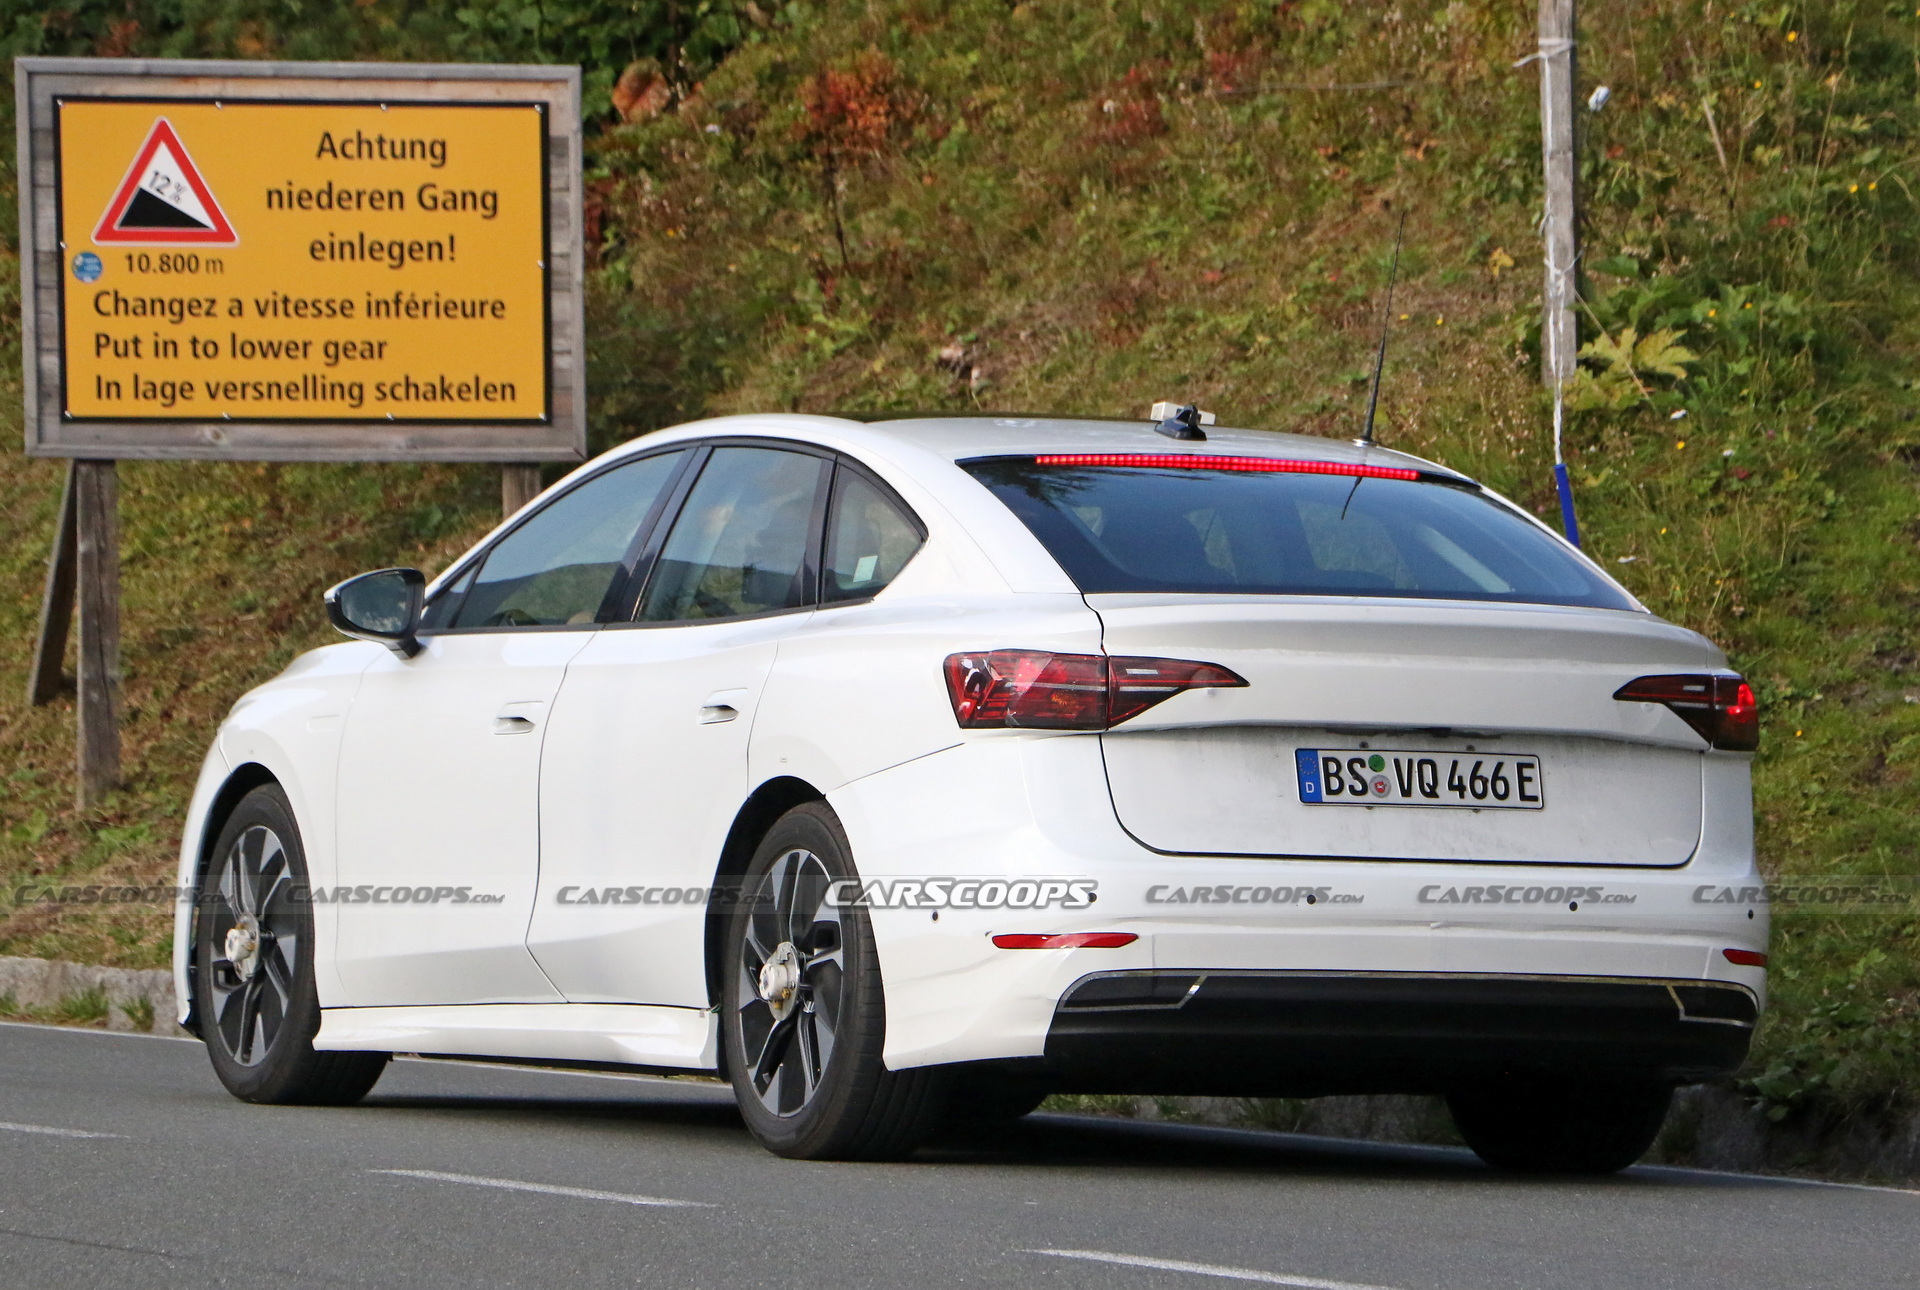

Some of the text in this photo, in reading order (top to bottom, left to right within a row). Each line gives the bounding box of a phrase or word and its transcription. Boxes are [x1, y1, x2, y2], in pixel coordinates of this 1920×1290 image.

[316, 131, 447, 168] Achtung
[266, 181, 498, 219] niederen Gang
[125, 253, 224, 275] 10.800 m
[309, 232, 456, 269] einlegen!
[93, 290, 506, 324] Changez a vitesse inférieure
[94, 332, 388, 367] Put in to lower gear
[95, 373, 516, 408] In lage versnelling schakelen
[1321, 757, 1368, 797] BS
[1393, 758, 1439, 799] VQ
